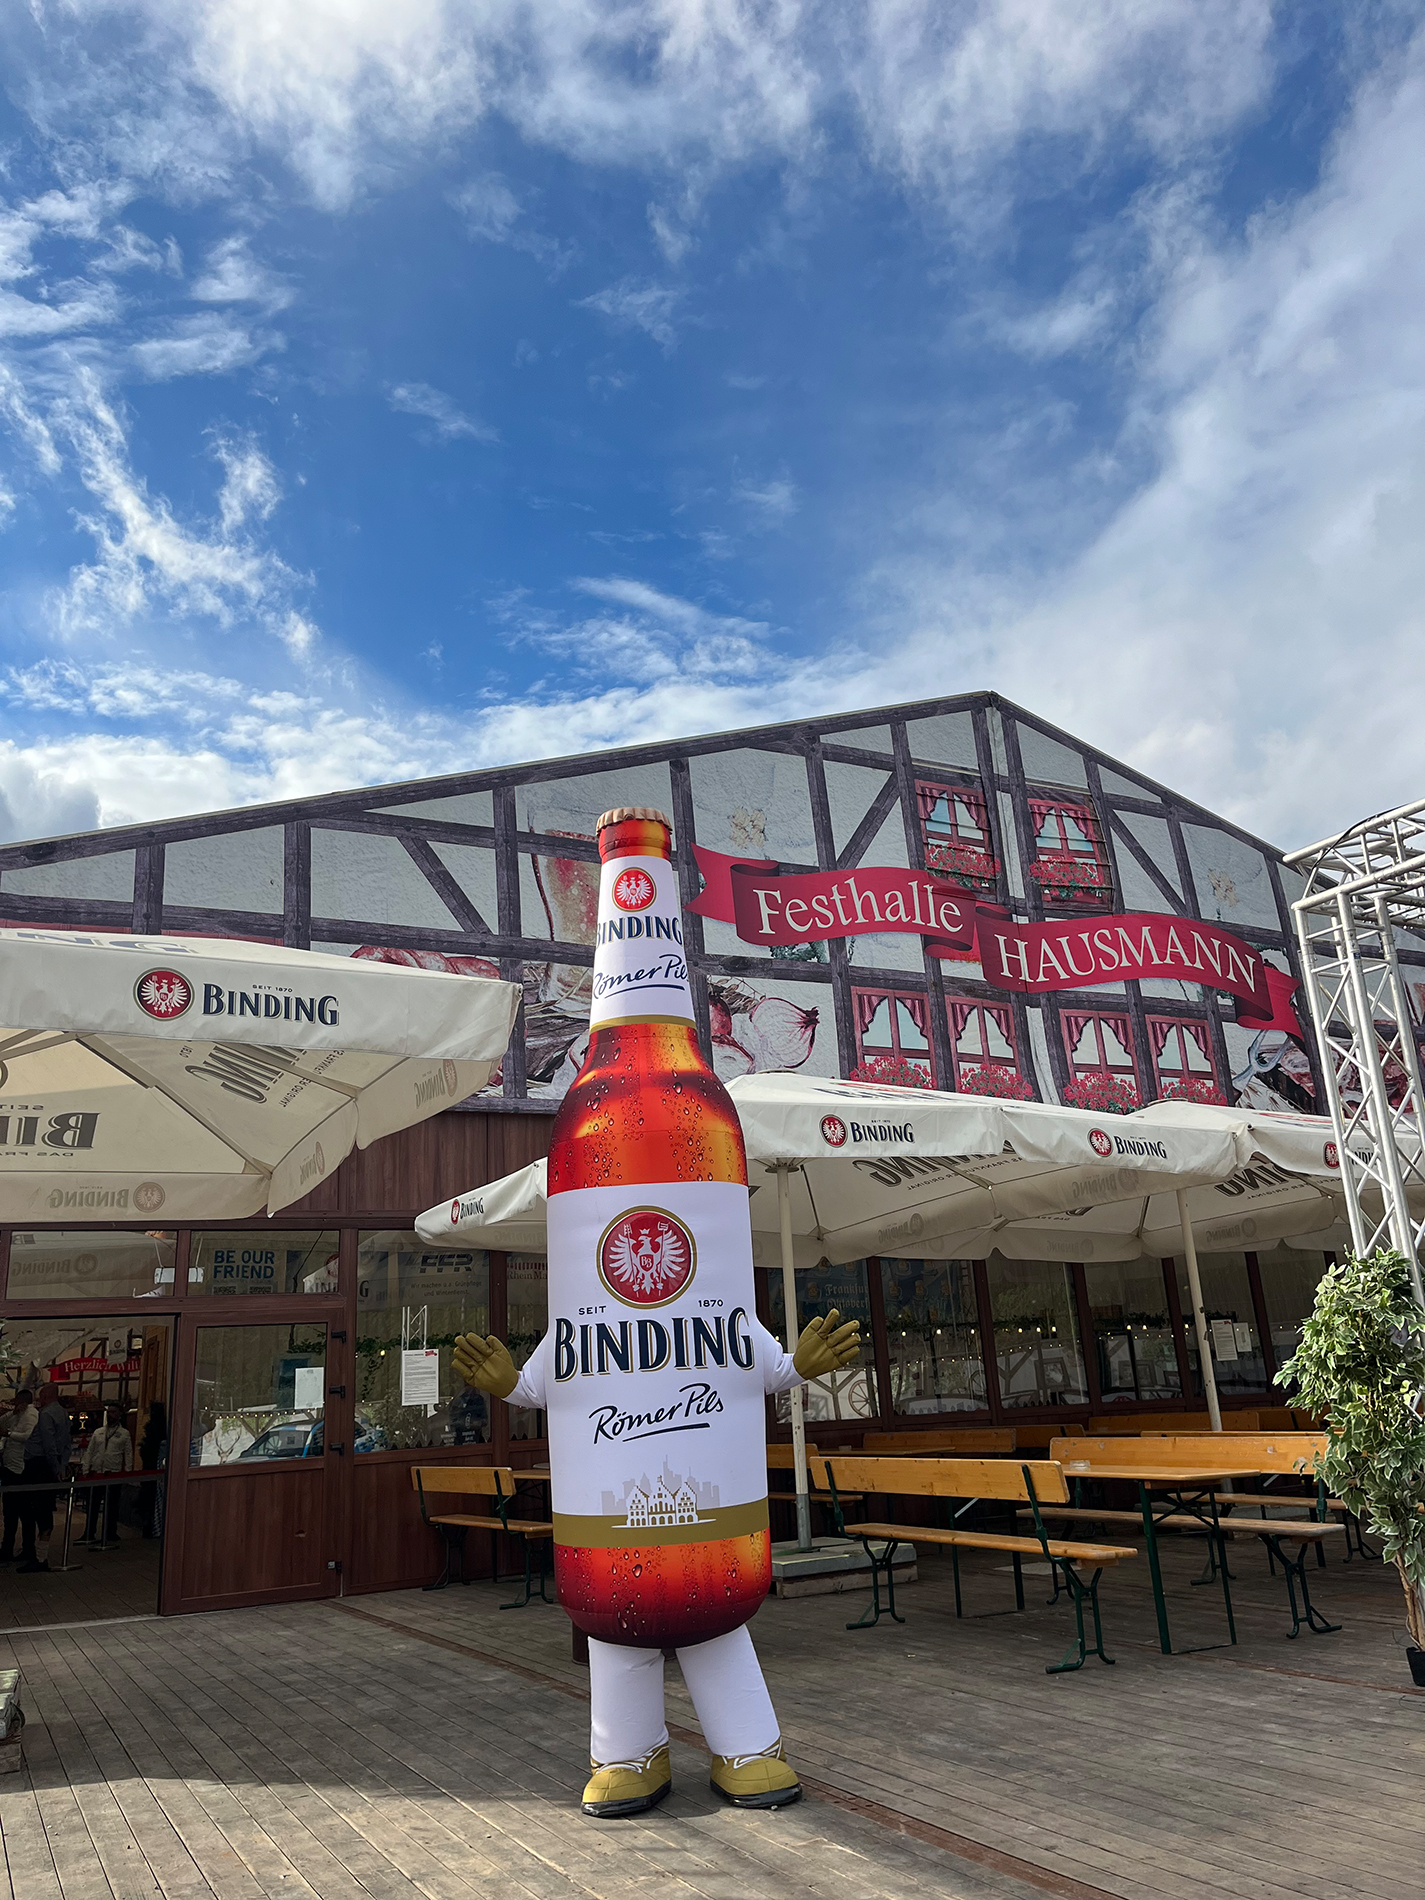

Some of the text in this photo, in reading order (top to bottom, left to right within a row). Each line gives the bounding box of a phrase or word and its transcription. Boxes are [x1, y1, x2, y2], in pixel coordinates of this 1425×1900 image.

[752, 876, 965, 936] Festhalle
[993, 925, 1257, 993] HAUSMANN
[202, 982, 340, 1028] BINDING
[849, 1121, 915, 1145] BINDING
[1113, 1135, 1168, 1160] BINDING
[460, 1197, 485, 1220] BINDING
[213, 1249, 276, 1265] BE OUR
[213, 1265, 275, 1280] FRIEND
[578, 1299, 724, 1316] SEIT 1870
[554, 1307, 755, 1383] BINDING
[588, 1382, 725, 1445] Römer Pils
